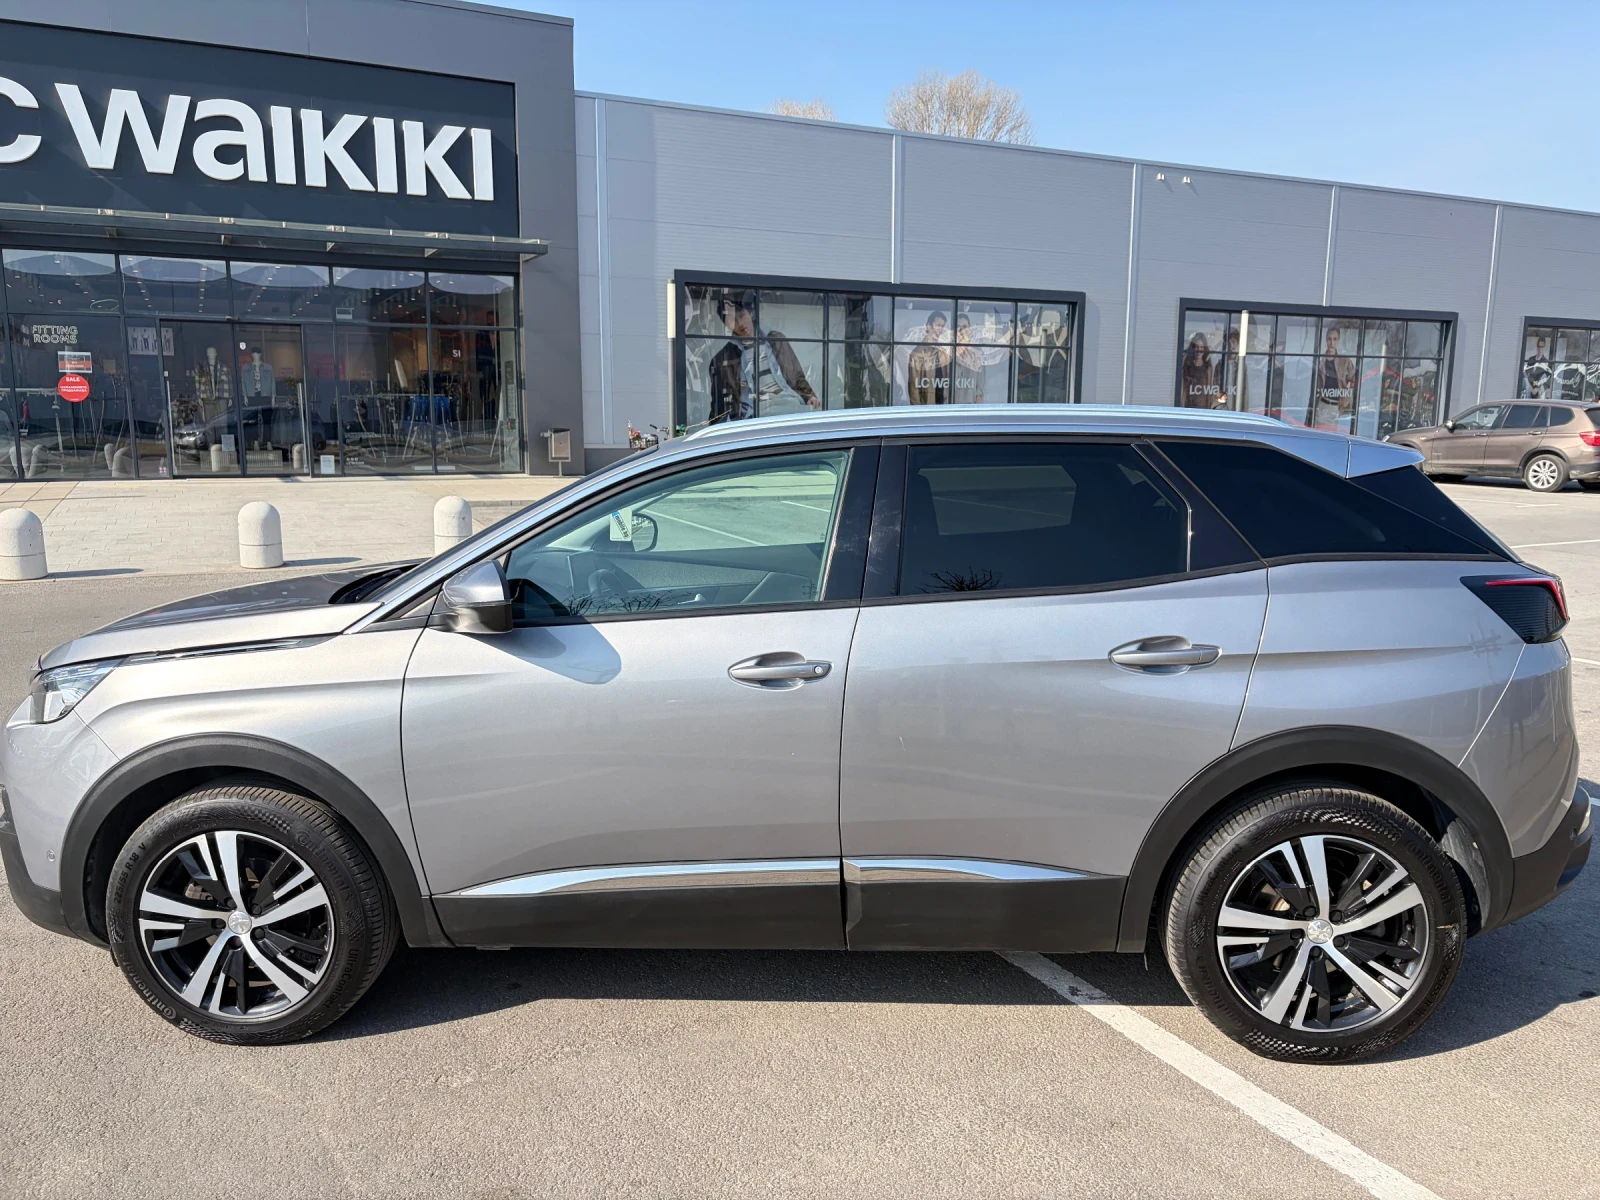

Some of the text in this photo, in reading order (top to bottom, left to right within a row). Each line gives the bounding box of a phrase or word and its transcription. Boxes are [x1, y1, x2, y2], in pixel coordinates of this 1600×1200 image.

[32, 325, 78, 335] FITTING
[33, 334, 78, 344] ROOMS
[915, 377, 930, 389] LC
[1189, 384, 1202, 395] LC
[122, 961, 177, 1020] Continental
